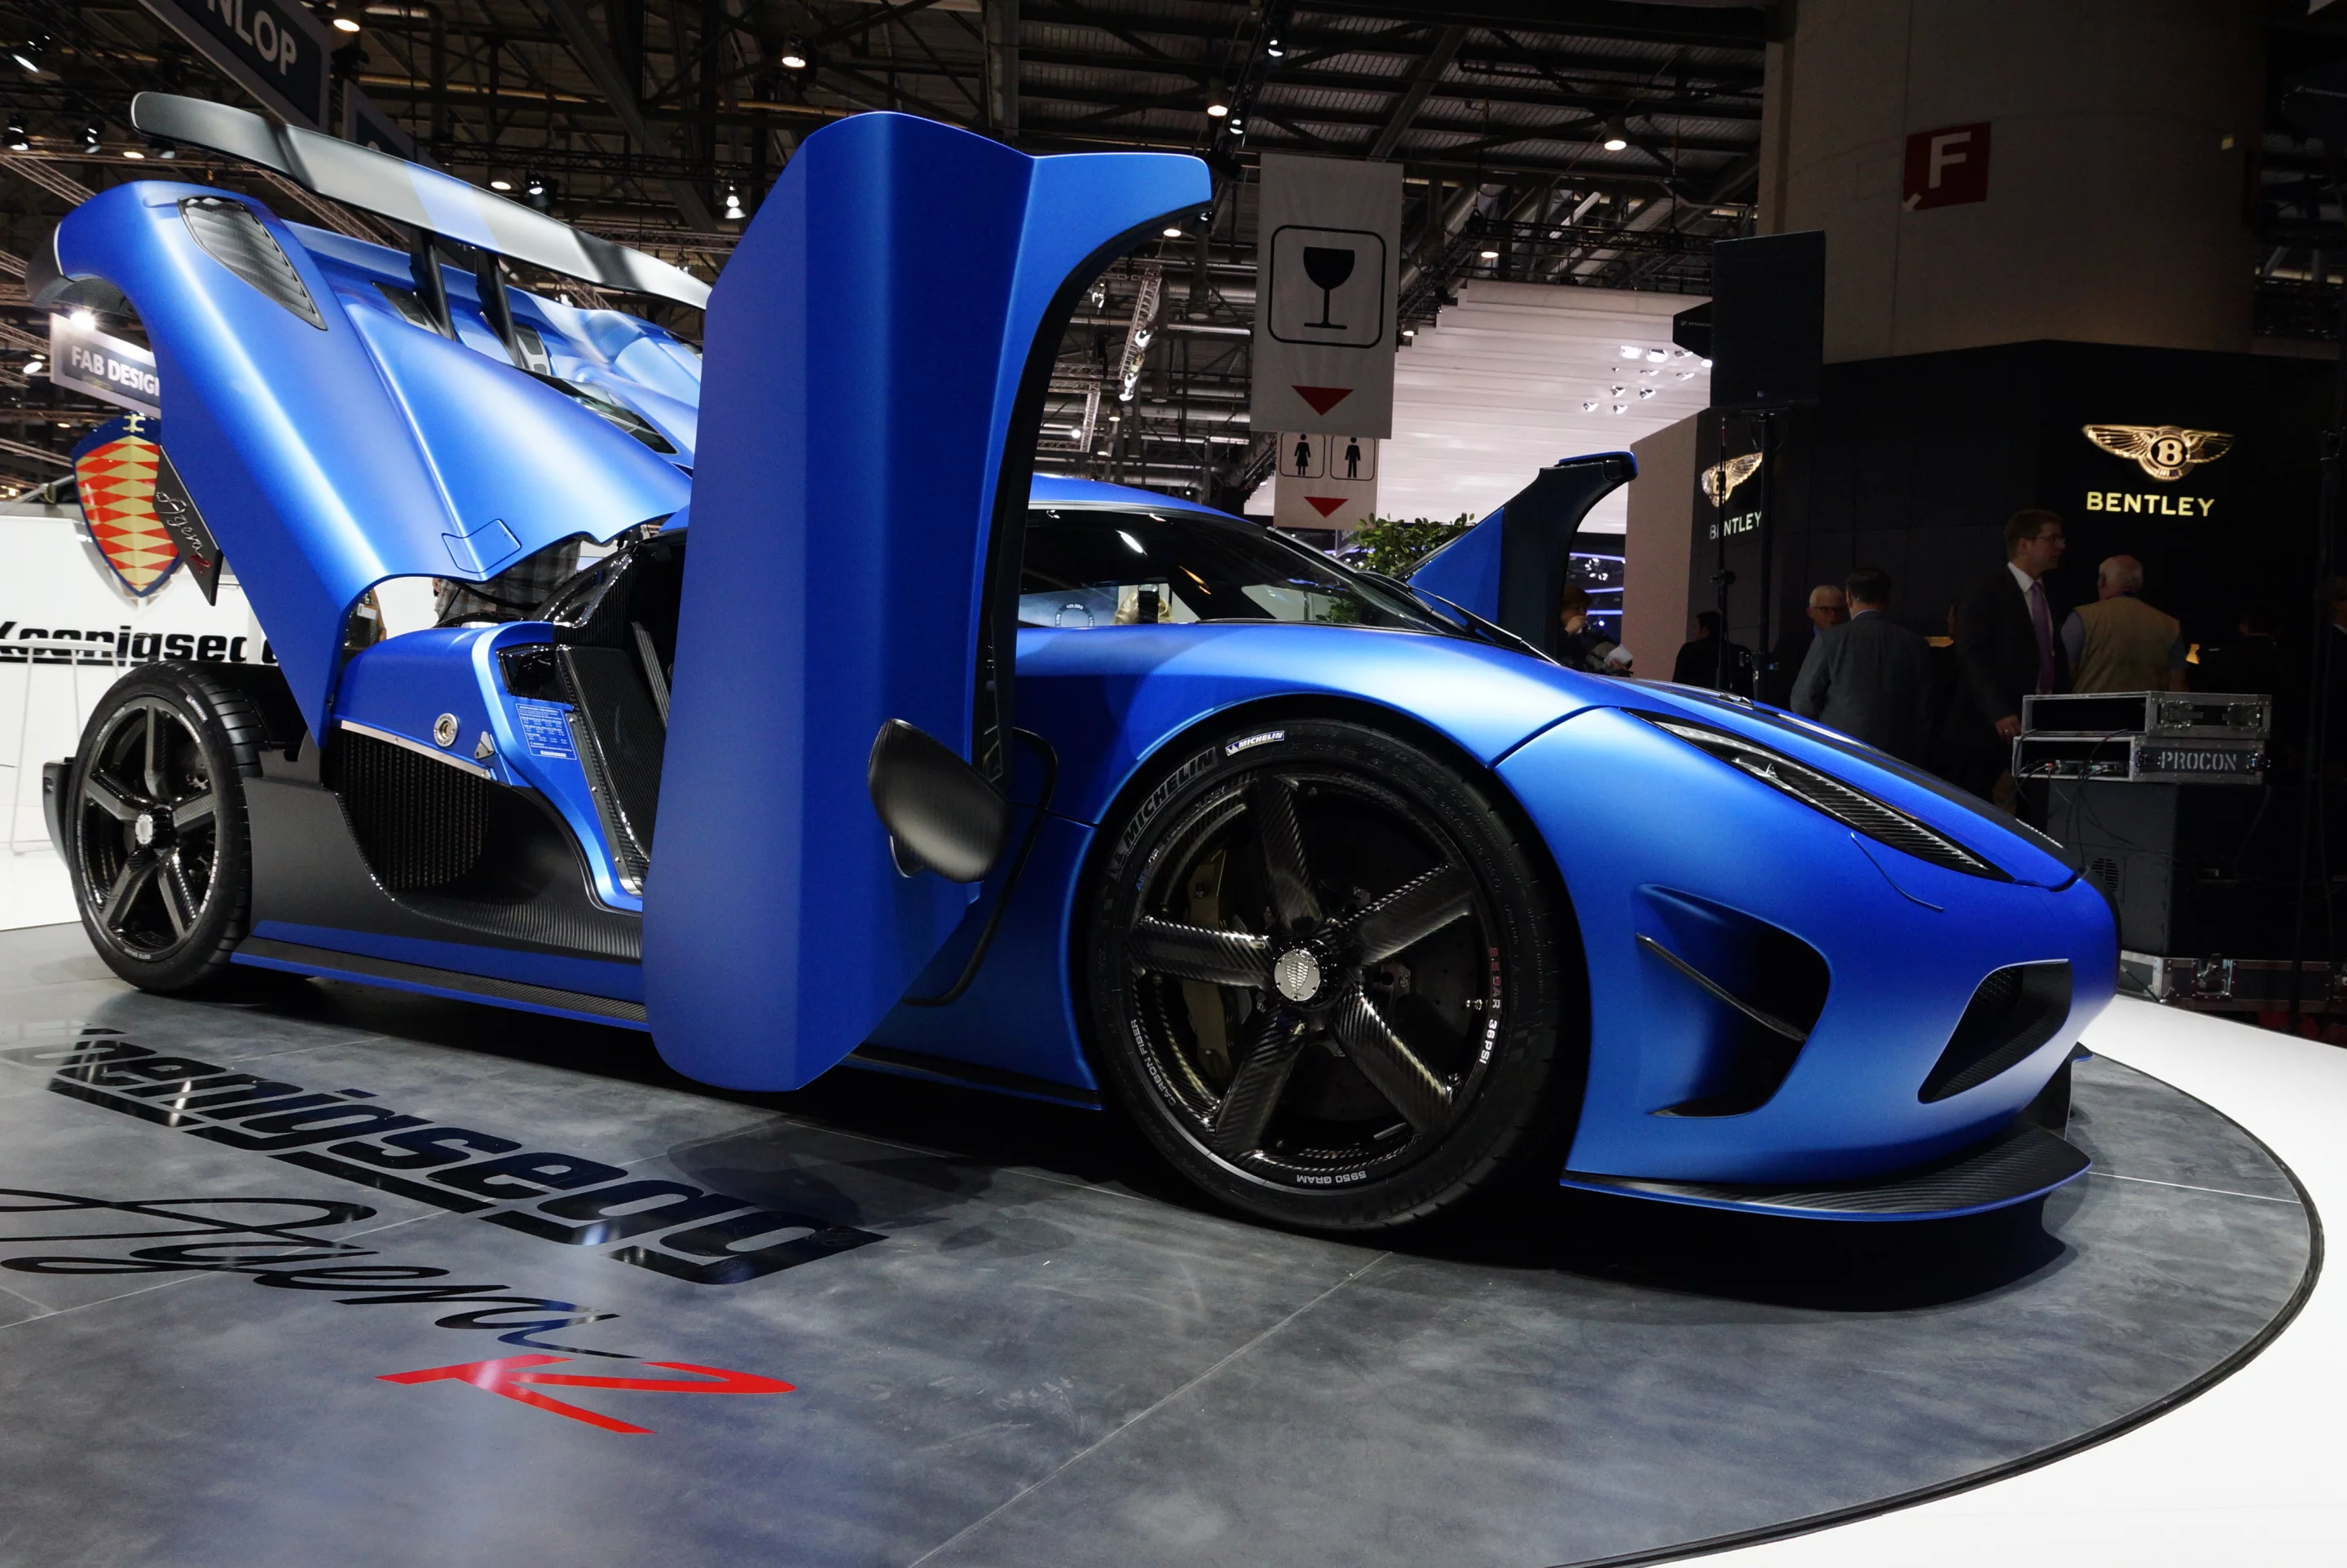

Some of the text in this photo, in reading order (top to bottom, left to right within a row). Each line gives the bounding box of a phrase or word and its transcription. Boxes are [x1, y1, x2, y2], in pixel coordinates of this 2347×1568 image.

[1928, 130, 1972, 188] F
[71, 346, 104, 376] FAB
[2086, 491, 2215, 517] BENTLEY
[1238, 732, 1284, 749] MICHELIN
[2160, 751, 2237, 771] PROCON
[1122, 750, 1214, 849] MICHELIN
[1130, 1019, 1177, 1107] CARBON FIBER
[0, 1024, 891, 1285] oenigsegg
[1297, 1170, 1367, 1184] 5950 GRAM
